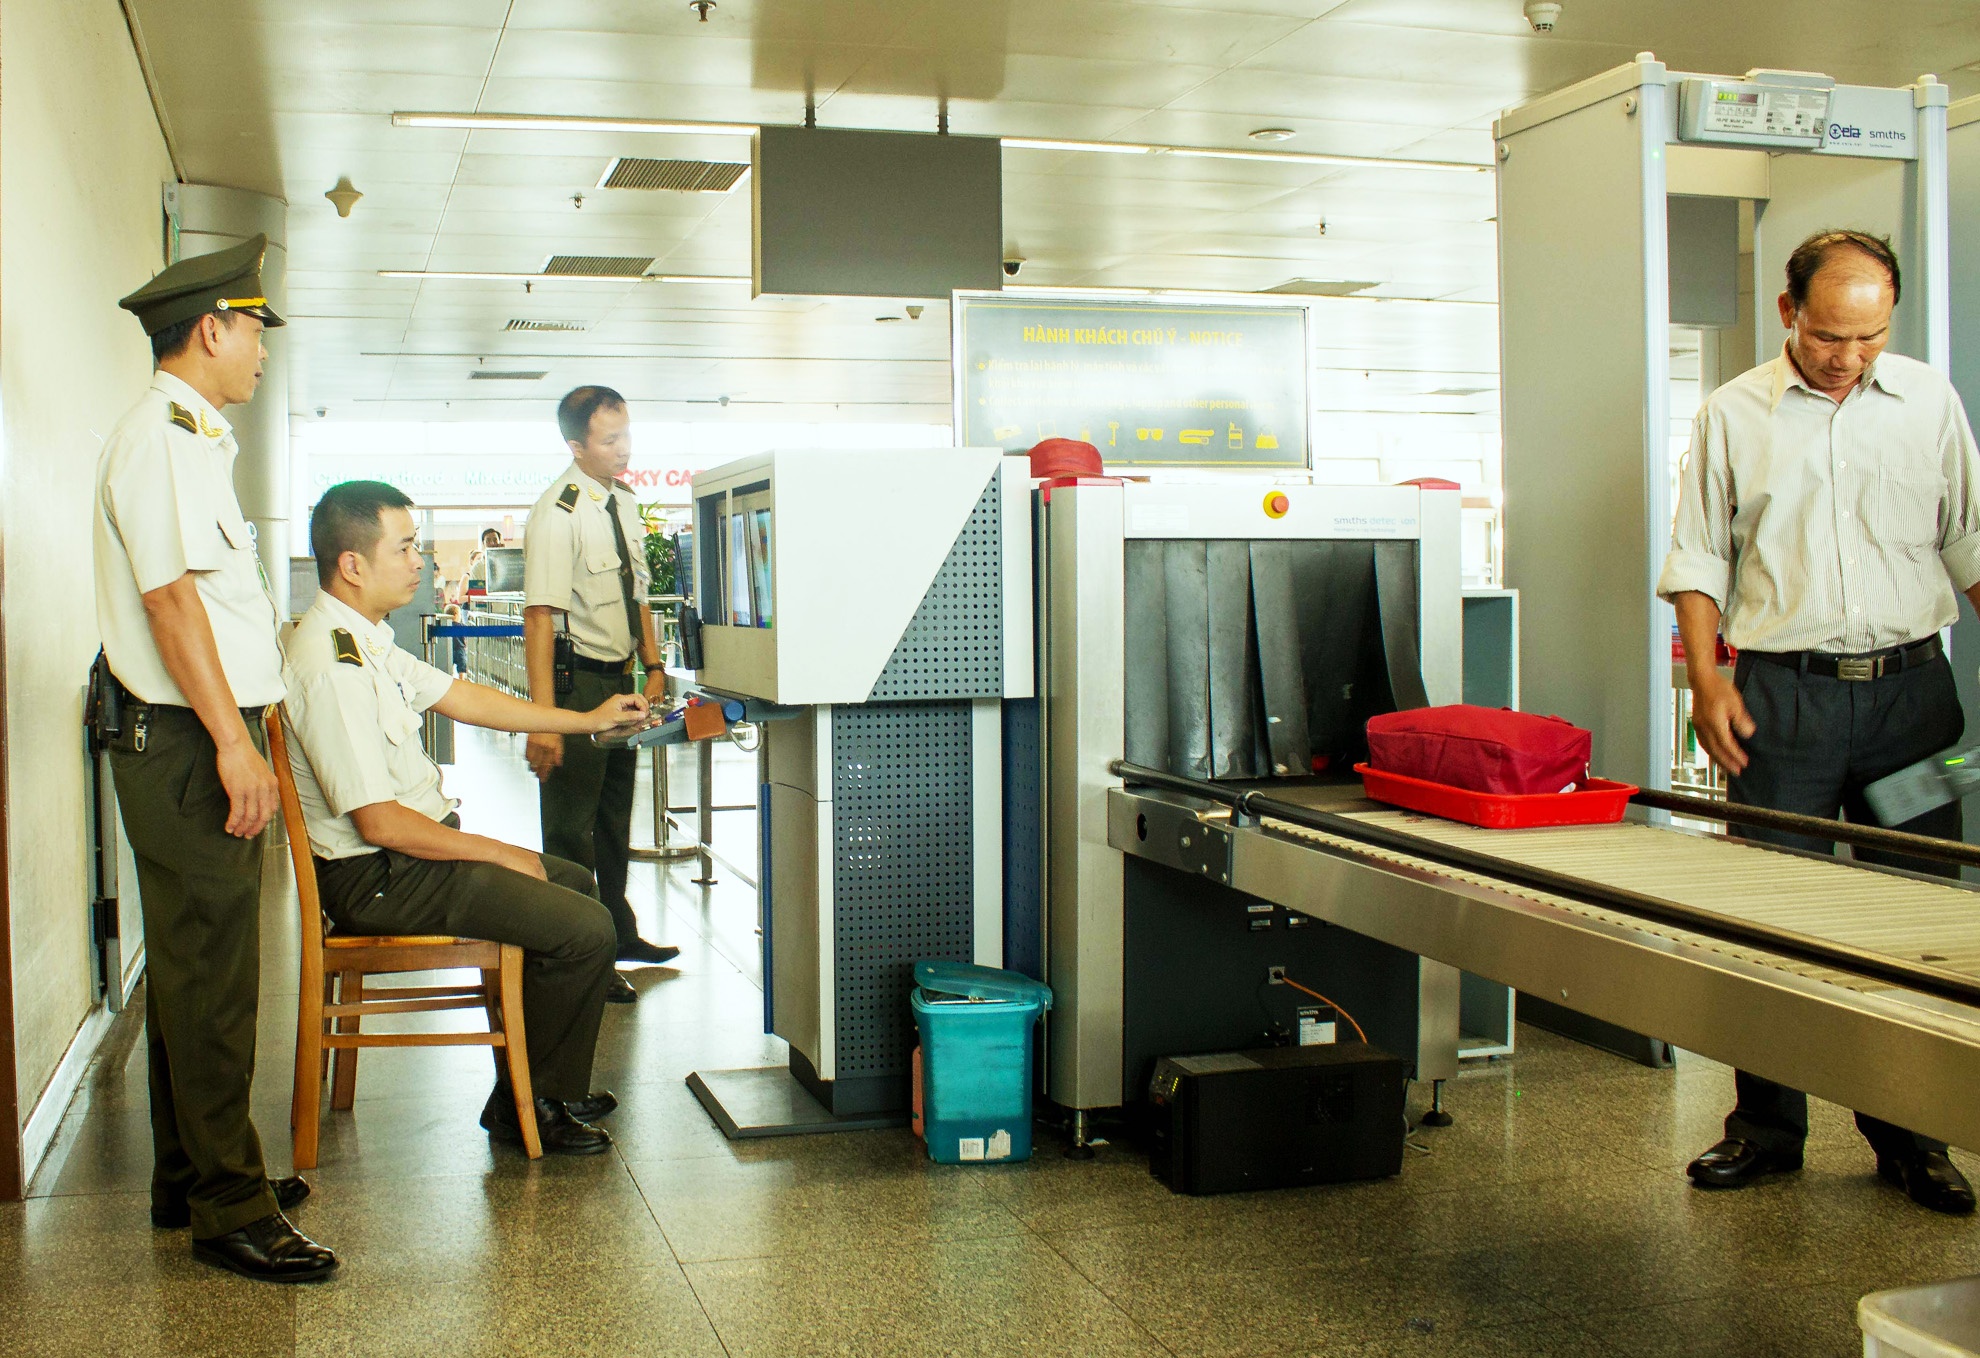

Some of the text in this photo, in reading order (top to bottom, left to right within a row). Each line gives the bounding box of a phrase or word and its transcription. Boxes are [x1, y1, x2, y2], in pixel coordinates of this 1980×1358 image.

[1869, 130, 1906, 140] smiths
[1023, 324, 1070, 343] HÀNH
[1074, 326, 1128, 345] KHÁCH
[1132, 327, 1163, 345] CHÚ
[1166, 328, 1177, 345] Ý
[1189, 330, 1243, 347] NOTICE
[1183, 398, 1208, 409] other
[1209, 399, 1248, 412] personal
[465, 470, 512, 485] Mixed
[1334, 517, 1367, 525] smiths
